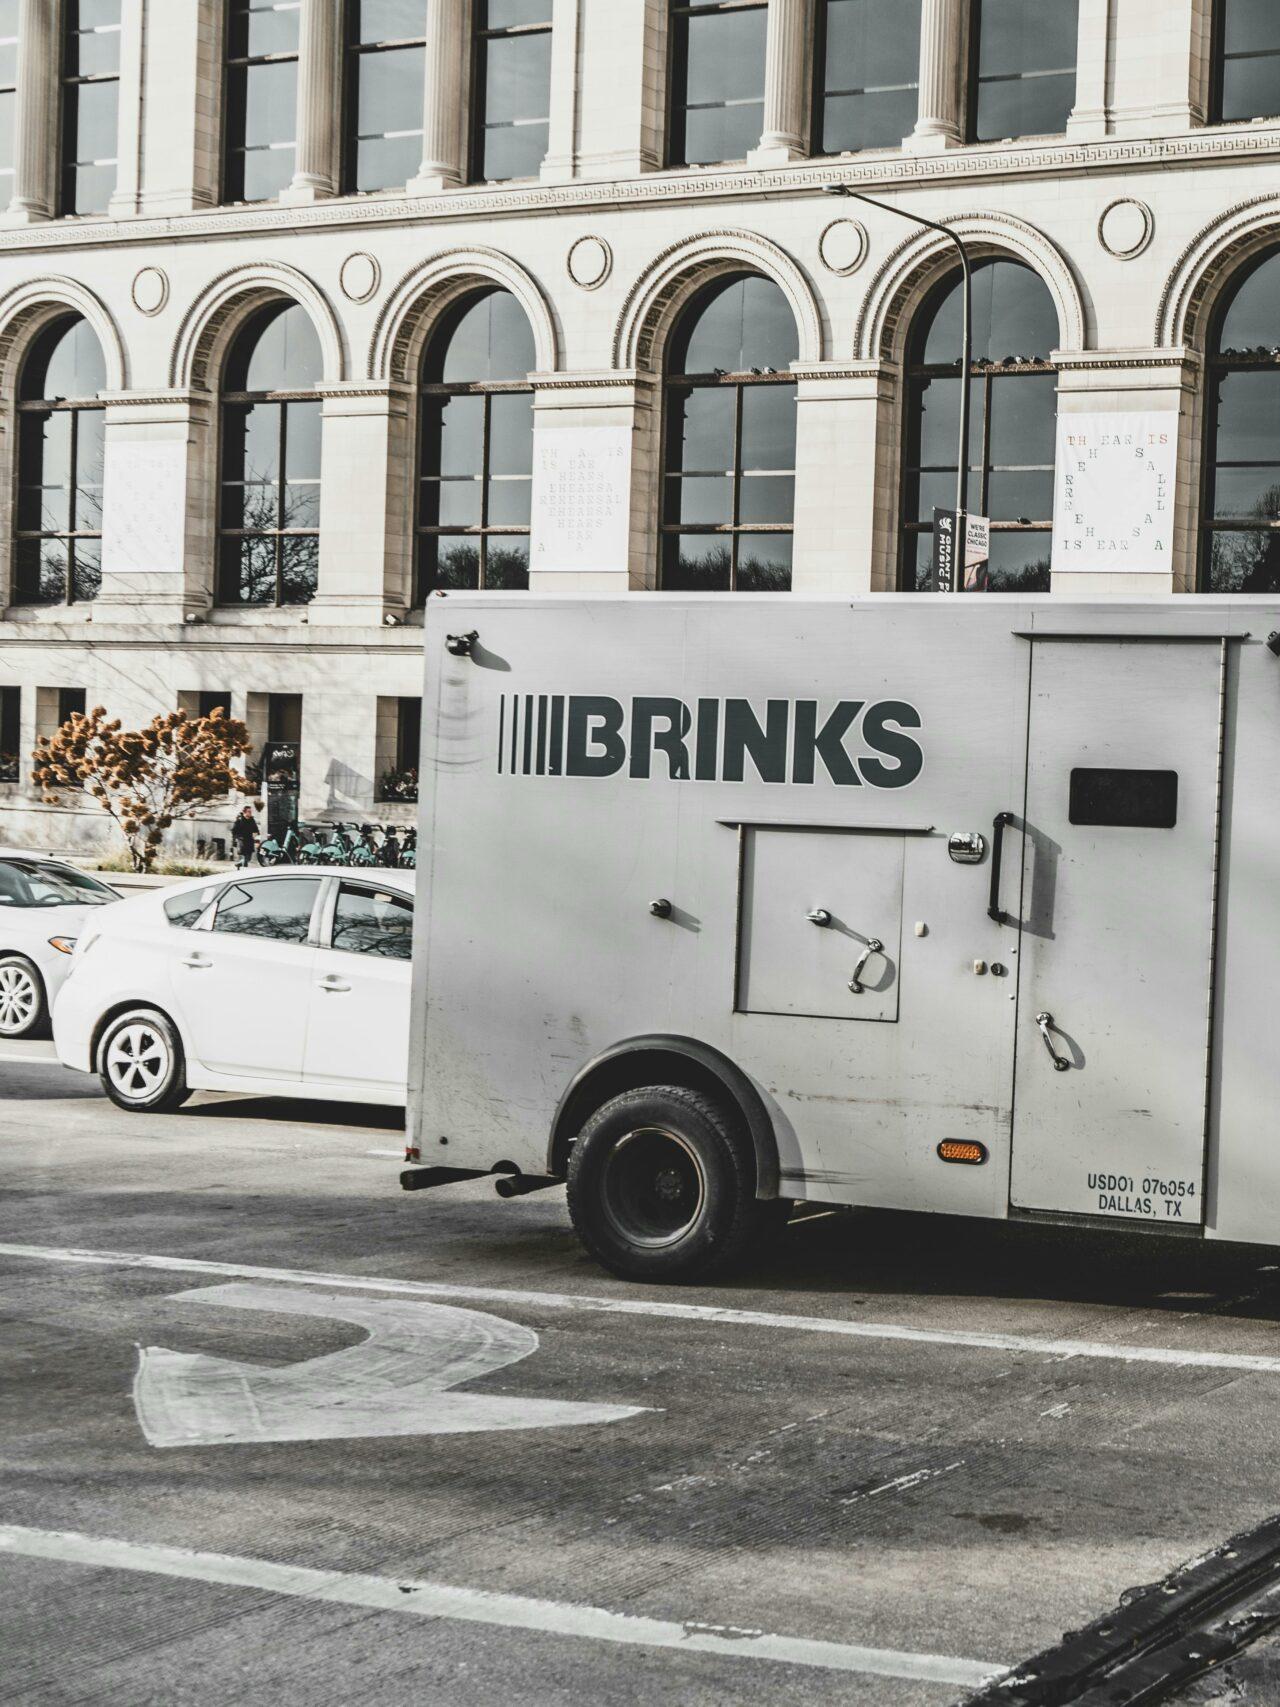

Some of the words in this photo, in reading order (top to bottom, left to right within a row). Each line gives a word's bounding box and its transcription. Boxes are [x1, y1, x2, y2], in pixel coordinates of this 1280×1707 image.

[1100, 434, 1132, 446] EAR
[1148, 434, 1168, 445] IS
[938, 534, 946, 577] MUSIC
[1063, 540, 1082, 550] IS
[1154, 540, 1164, 551] A
[944, 535, 952, 580] GRANT
[565, 694, 924, 790] BRINKS
[1142, 1178, 1196, 1197] 076054
[1098, 1194, 1156, 1217] DALLAS,
[1165, 1200, 1182, 1217] TX
